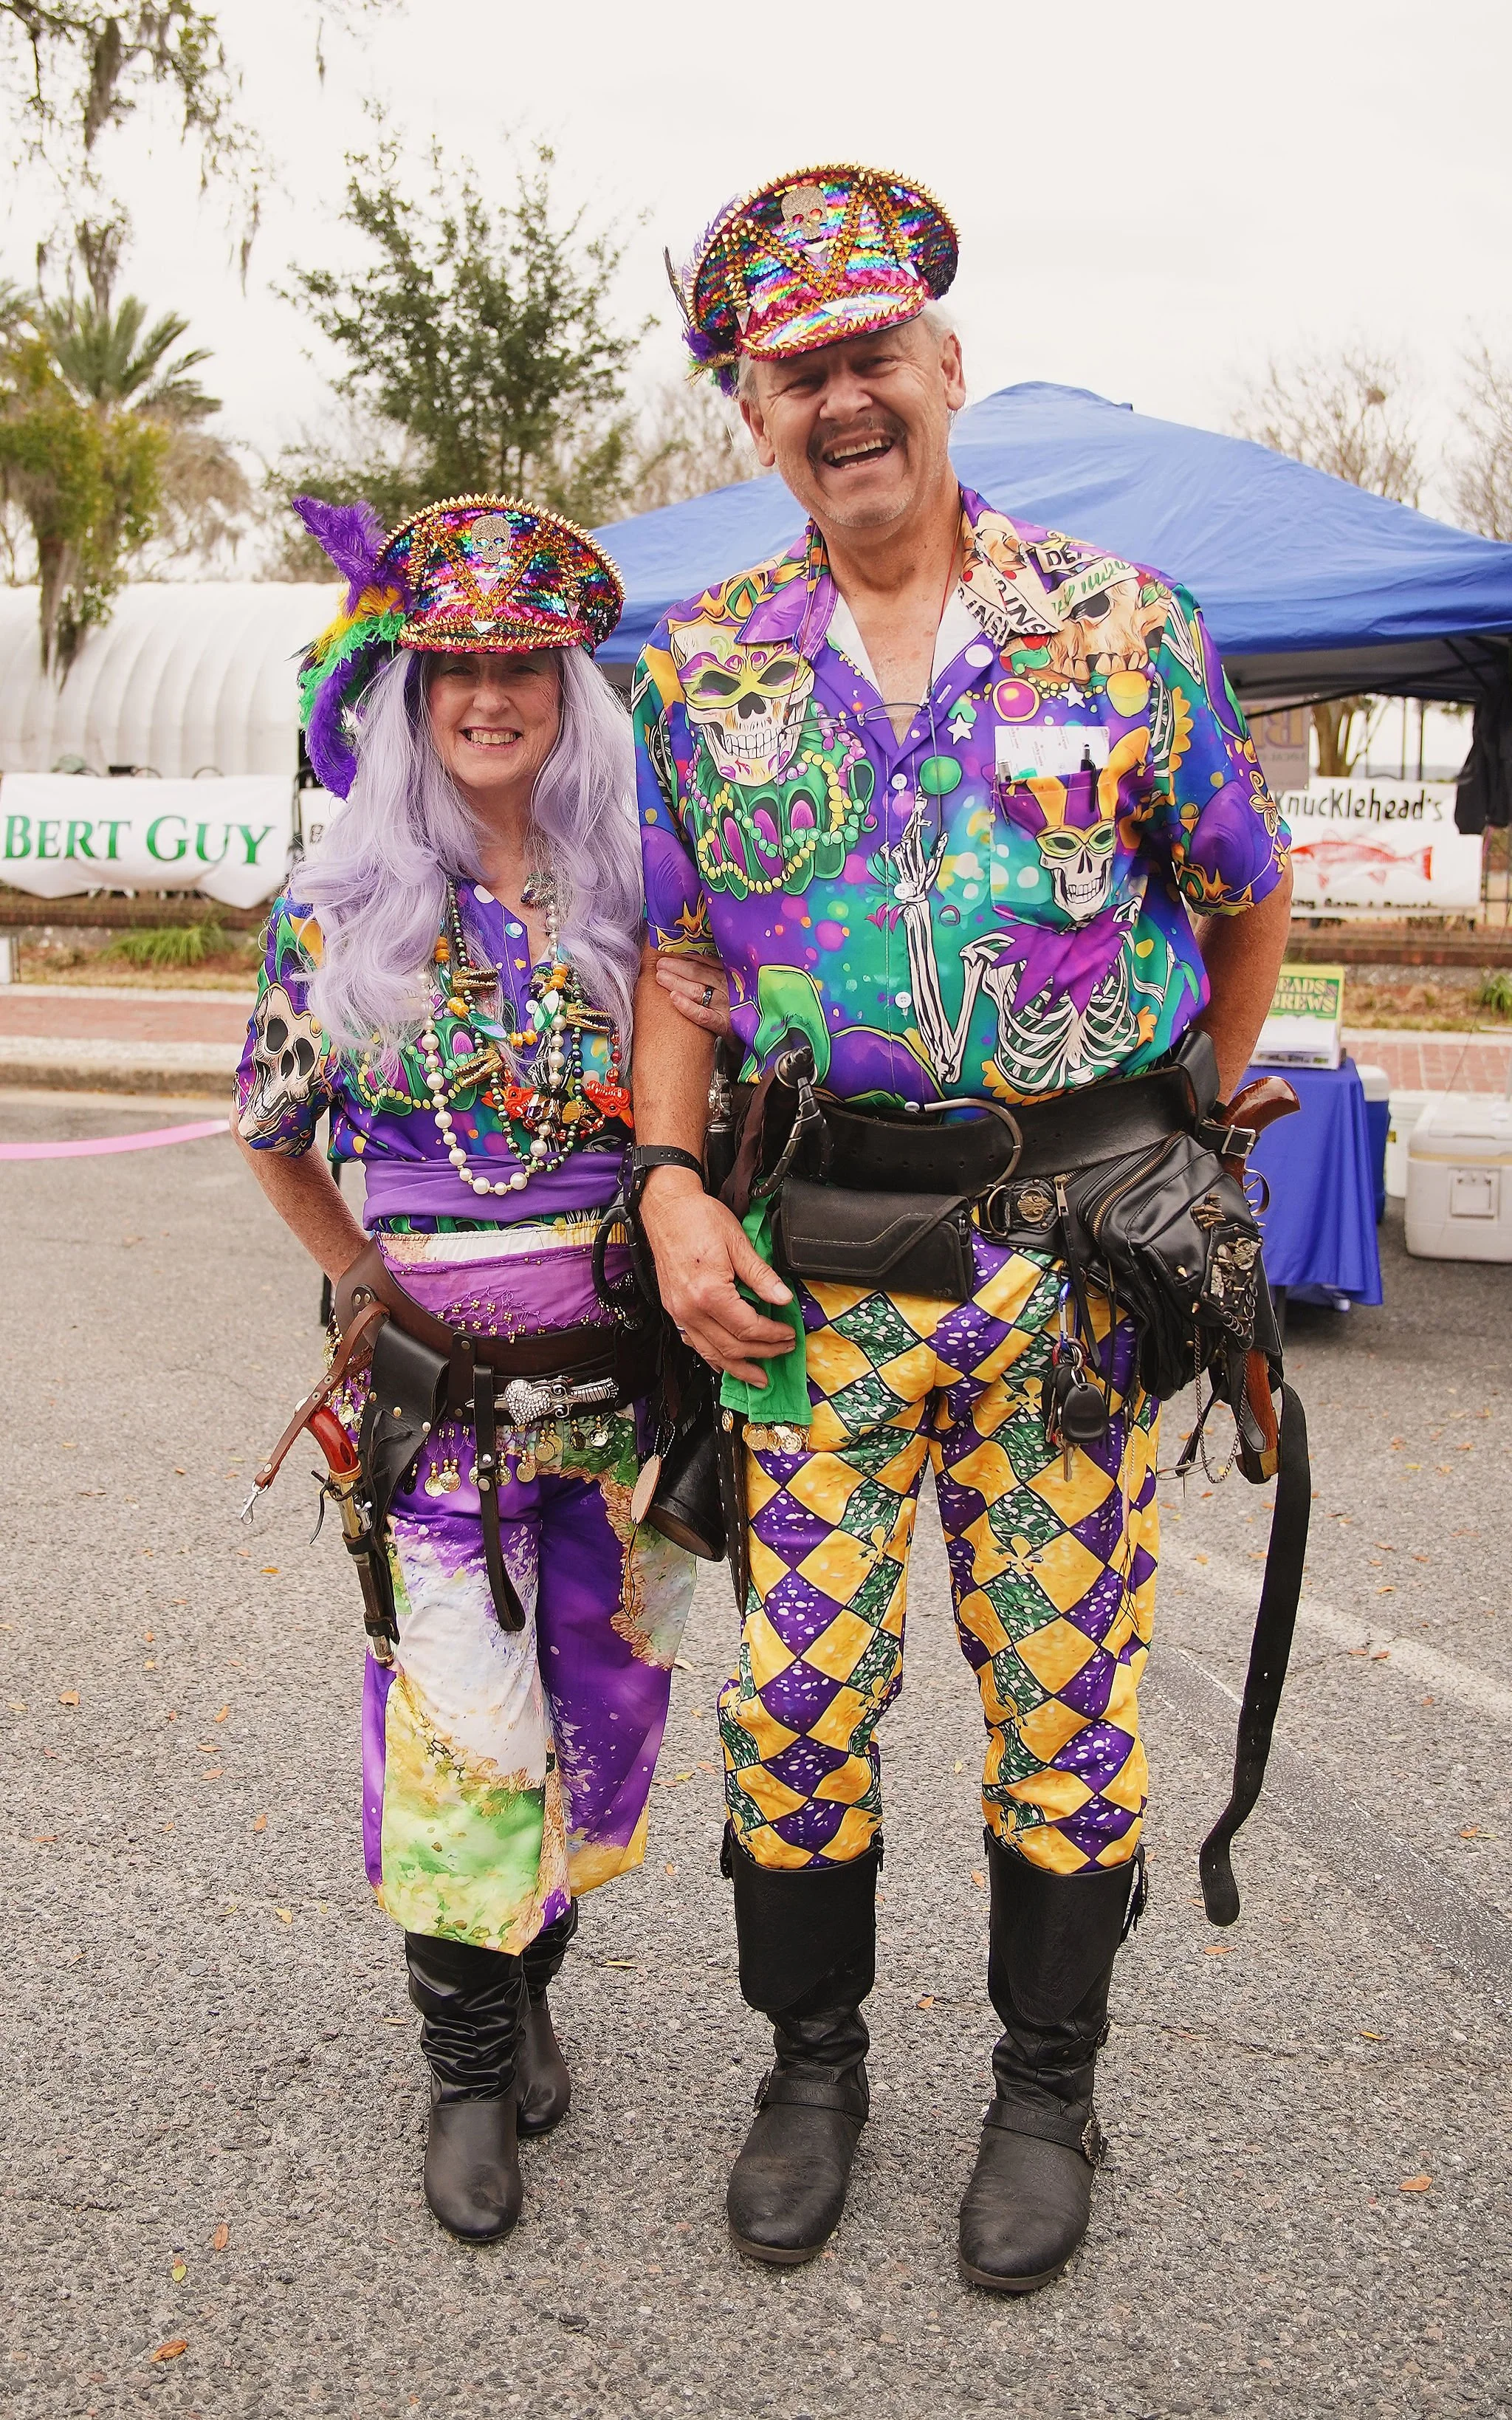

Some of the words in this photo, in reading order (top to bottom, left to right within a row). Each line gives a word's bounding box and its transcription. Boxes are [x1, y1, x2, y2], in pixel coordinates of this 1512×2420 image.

[2, 815, 132, 861] BERT
[146, 815, 277, 865] GUY
[1277, 977, 1327, 995] EADS
